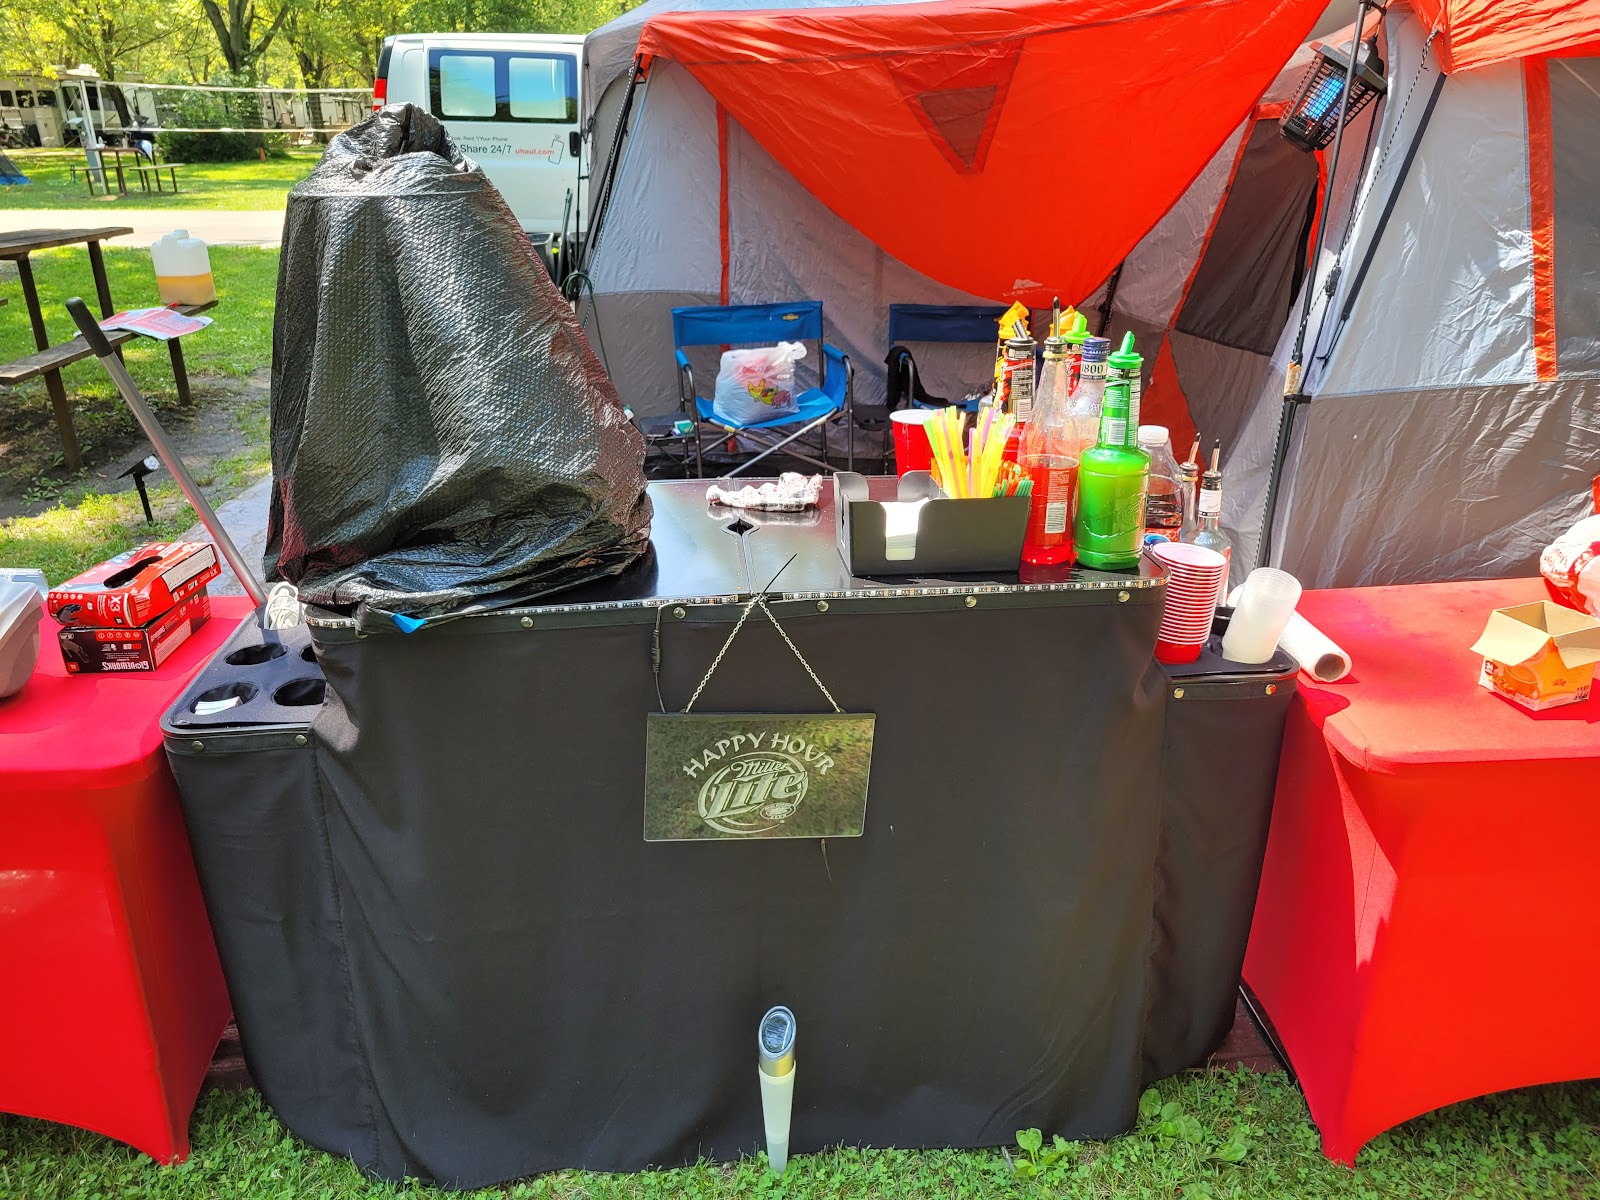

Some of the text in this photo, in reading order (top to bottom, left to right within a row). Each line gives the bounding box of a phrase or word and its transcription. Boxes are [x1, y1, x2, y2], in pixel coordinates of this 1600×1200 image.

[460, 143, 512, 156] Share 24/7
[515, 148, 555, 156] uhaul.com
[110, 594, 122, 613] X3
[682, 731, 835, 778] HAPPY HOUR
[731, 760, 793, 776] Miller
[704, 771, 808, 819] Lite
